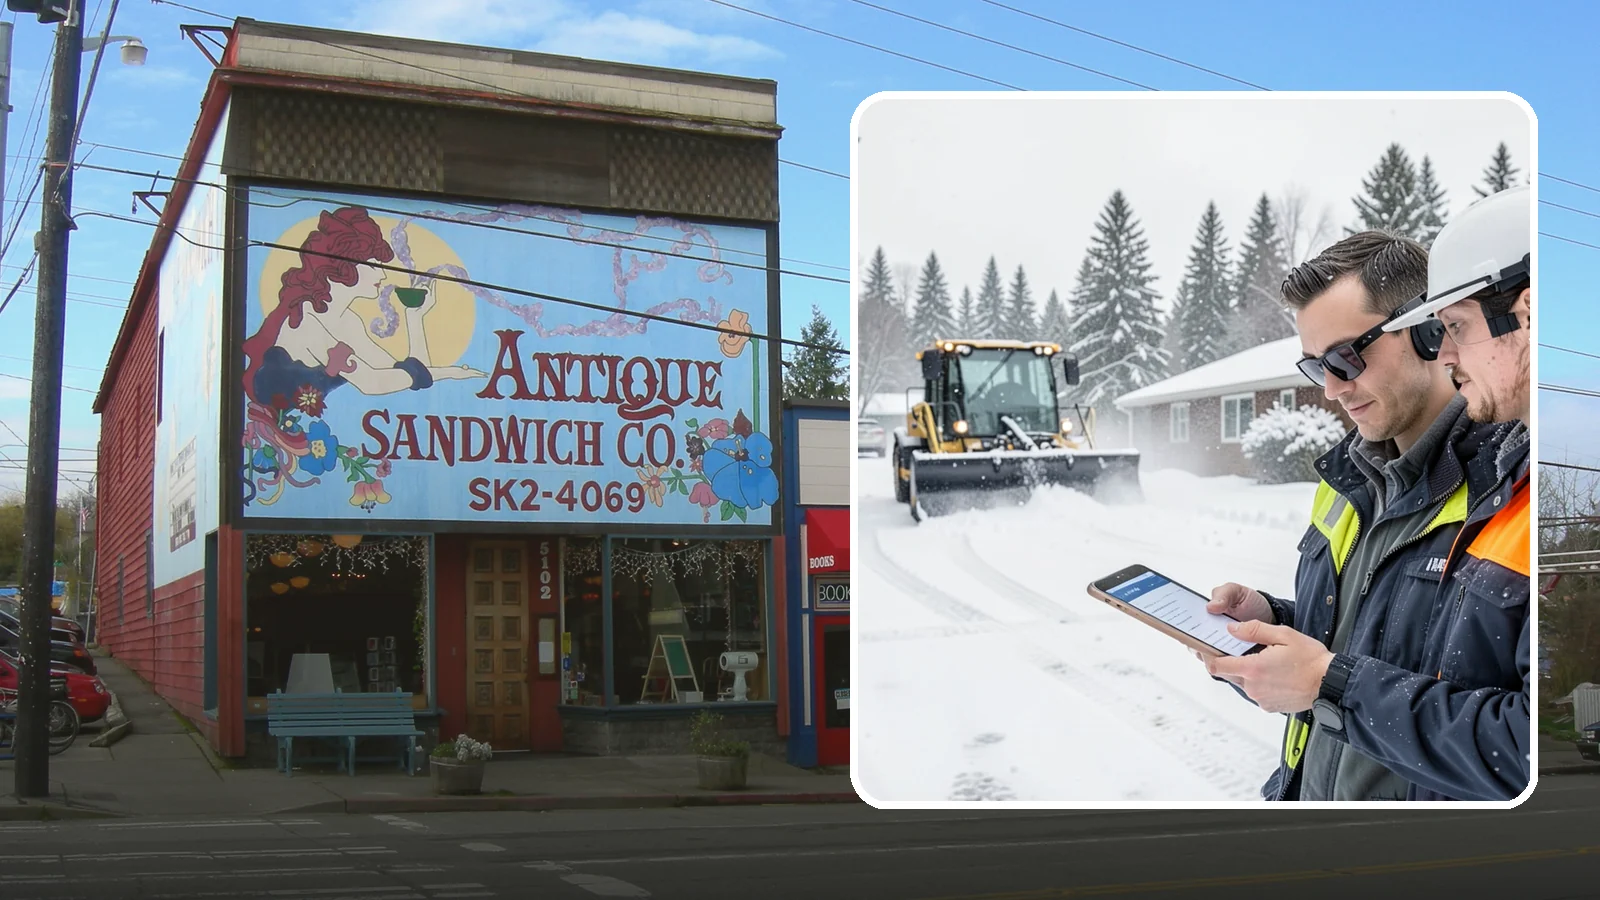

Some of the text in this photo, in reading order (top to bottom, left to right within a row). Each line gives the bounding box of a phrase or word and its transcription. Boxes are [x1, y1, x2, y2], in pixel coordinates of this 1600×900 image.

[475, 329, 724, 421] ANTIQUE
[361, 408, 685, 469] SANDWICH CO.
[468, 477, 646, 513] SK2-4069
[540, 542, 553, 600] 5102
[809, 555, 834, 569] BOOKS
